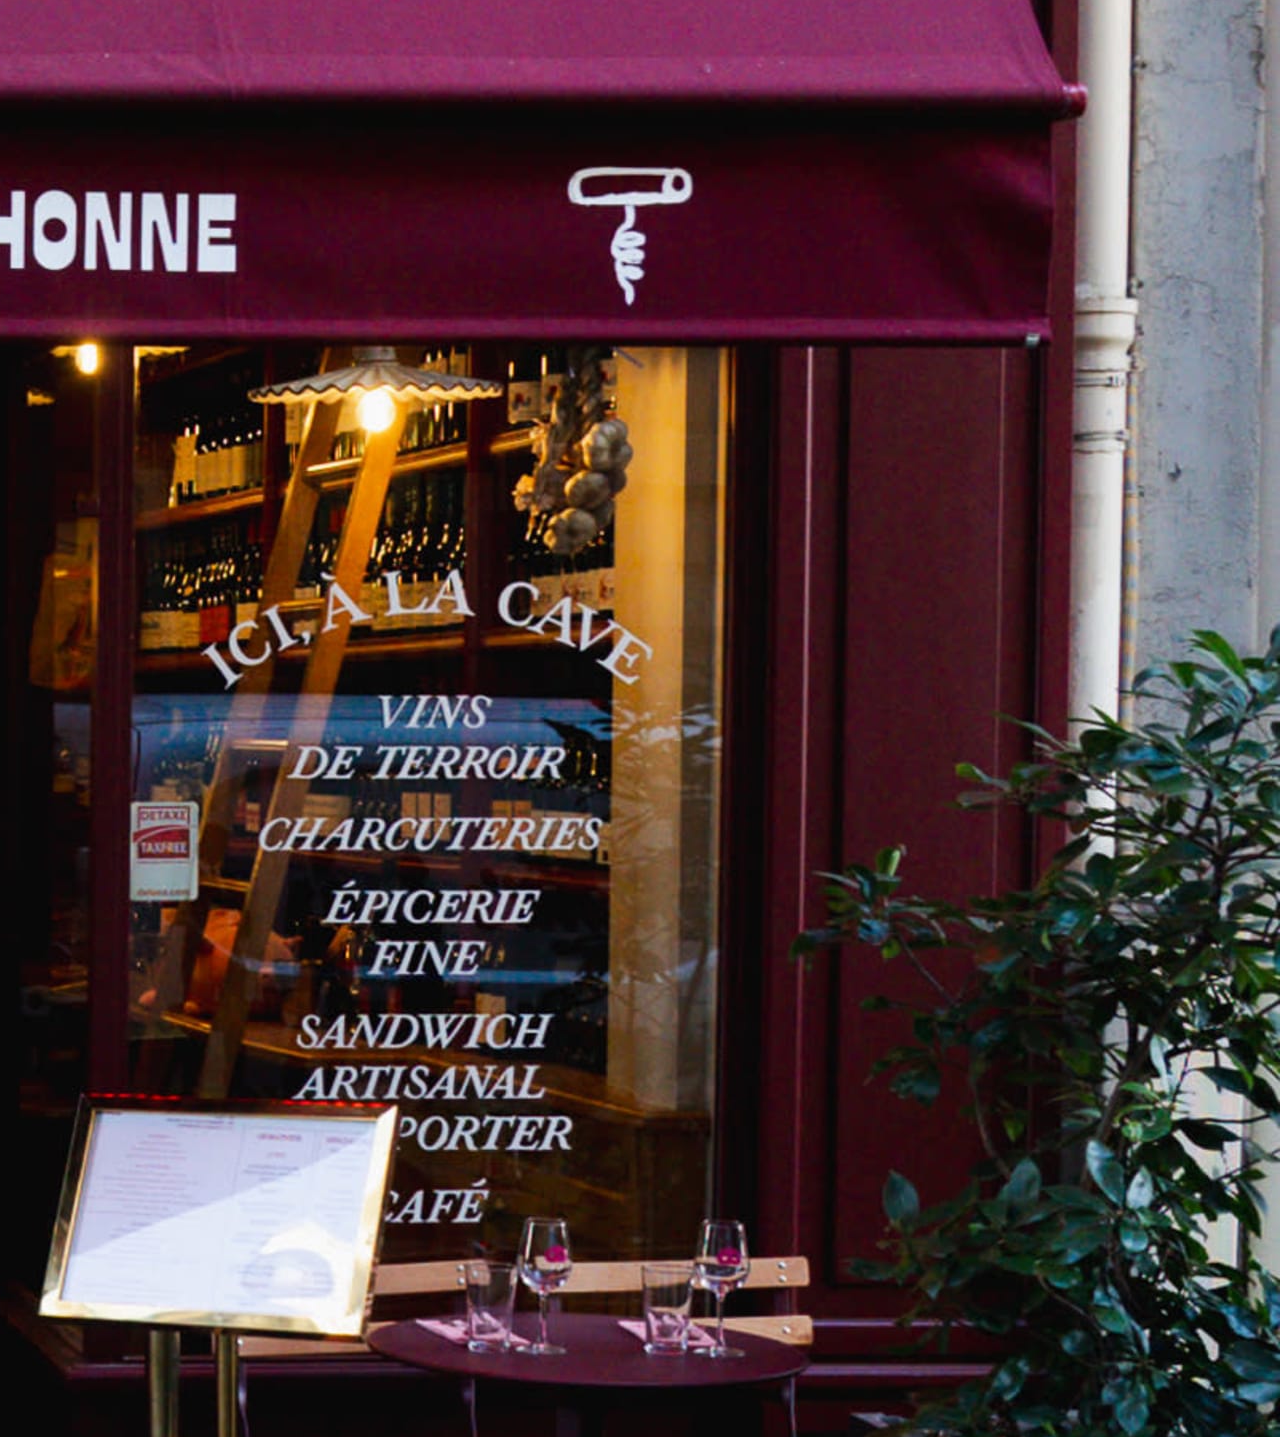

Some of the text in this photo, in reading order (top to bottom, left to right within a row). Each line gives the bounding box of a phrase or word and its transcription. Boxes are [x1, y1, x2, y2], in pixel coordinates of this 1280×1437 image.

[202, 569, 655, 689] ICI, À LA CAVE
[379, 694, 493, 730] VINS
[287, 744, 566, 781] DE TERROIR
[257, 816, 603, 853] CHARCUTERIES
[322, 880, 541, 925] ÉPICERIE
[366, 939, 486, 977] FINE
[295, 1012, 554, 1050] SANDWICH
[292, 1064, 547, 1101] ARTISANAL
